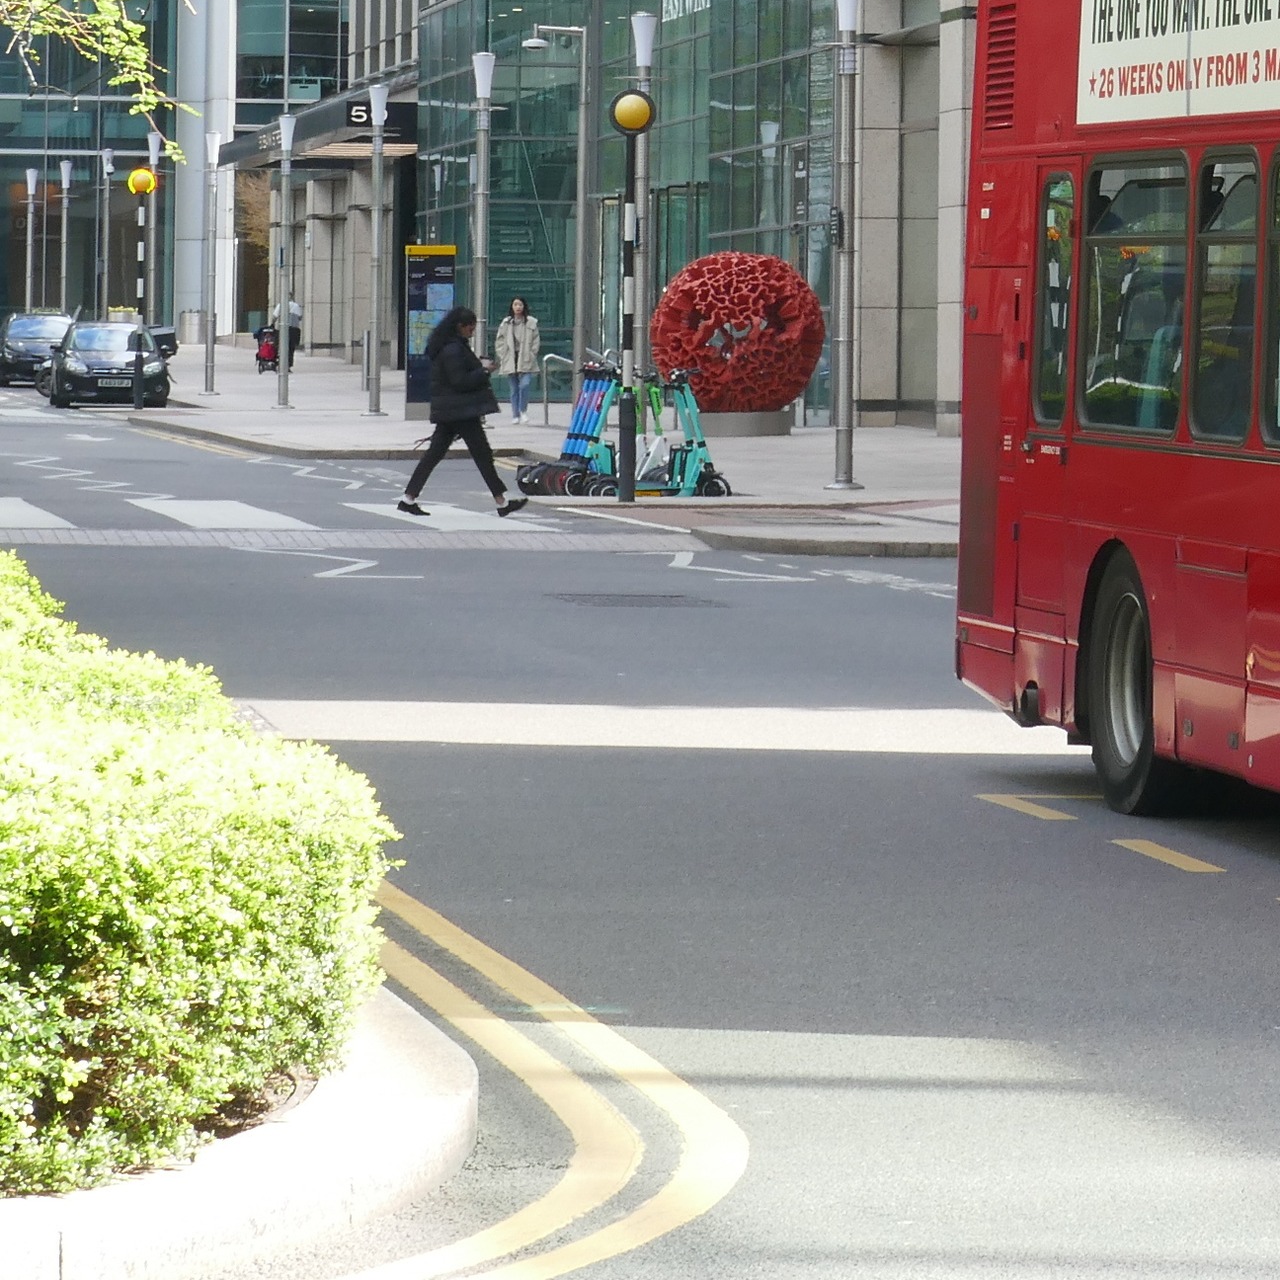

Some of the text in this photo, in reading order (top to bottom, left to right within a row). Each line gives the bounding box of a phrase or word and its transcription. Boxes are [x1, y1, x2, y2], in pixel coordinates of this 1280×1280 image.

[1099, 67, 1114, 98] 26
[1118, 62, 1163, 96] WEEKS
[1167, 57, 1202, 92] ONLY
[1207, 52, 1248, 88] FROM
[1252, 50, 1260, 83] 3
